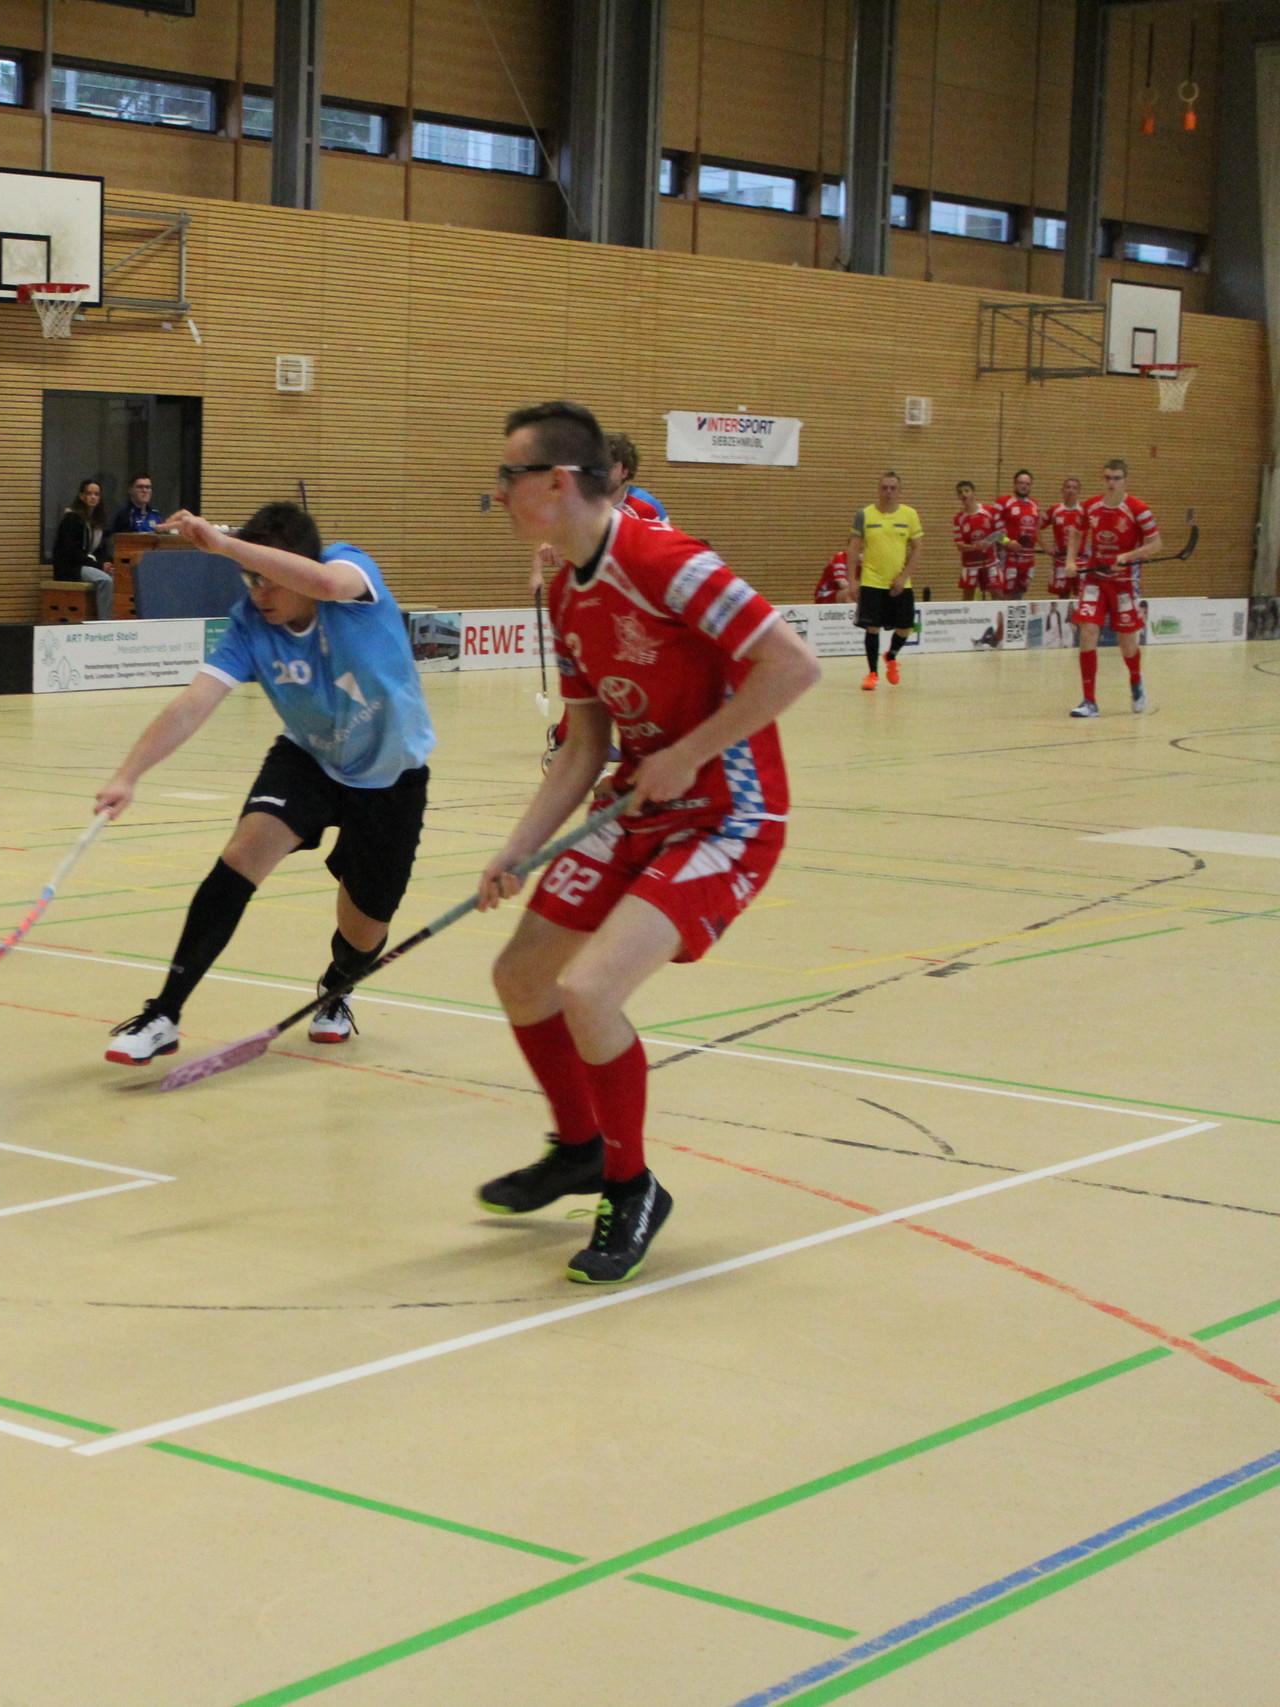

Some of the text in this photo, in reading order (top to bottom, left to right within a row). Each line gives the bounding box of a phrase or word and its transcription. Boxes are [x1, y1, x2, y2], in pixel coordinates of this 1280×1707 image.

[707, 417, 775, 435] INTERSPORT
[66, 633, 82, 643] ART
[464, 624, 525, 656] REWE
[271, 660, 312, 685] 20
[541, 856, 603, 907] 82
